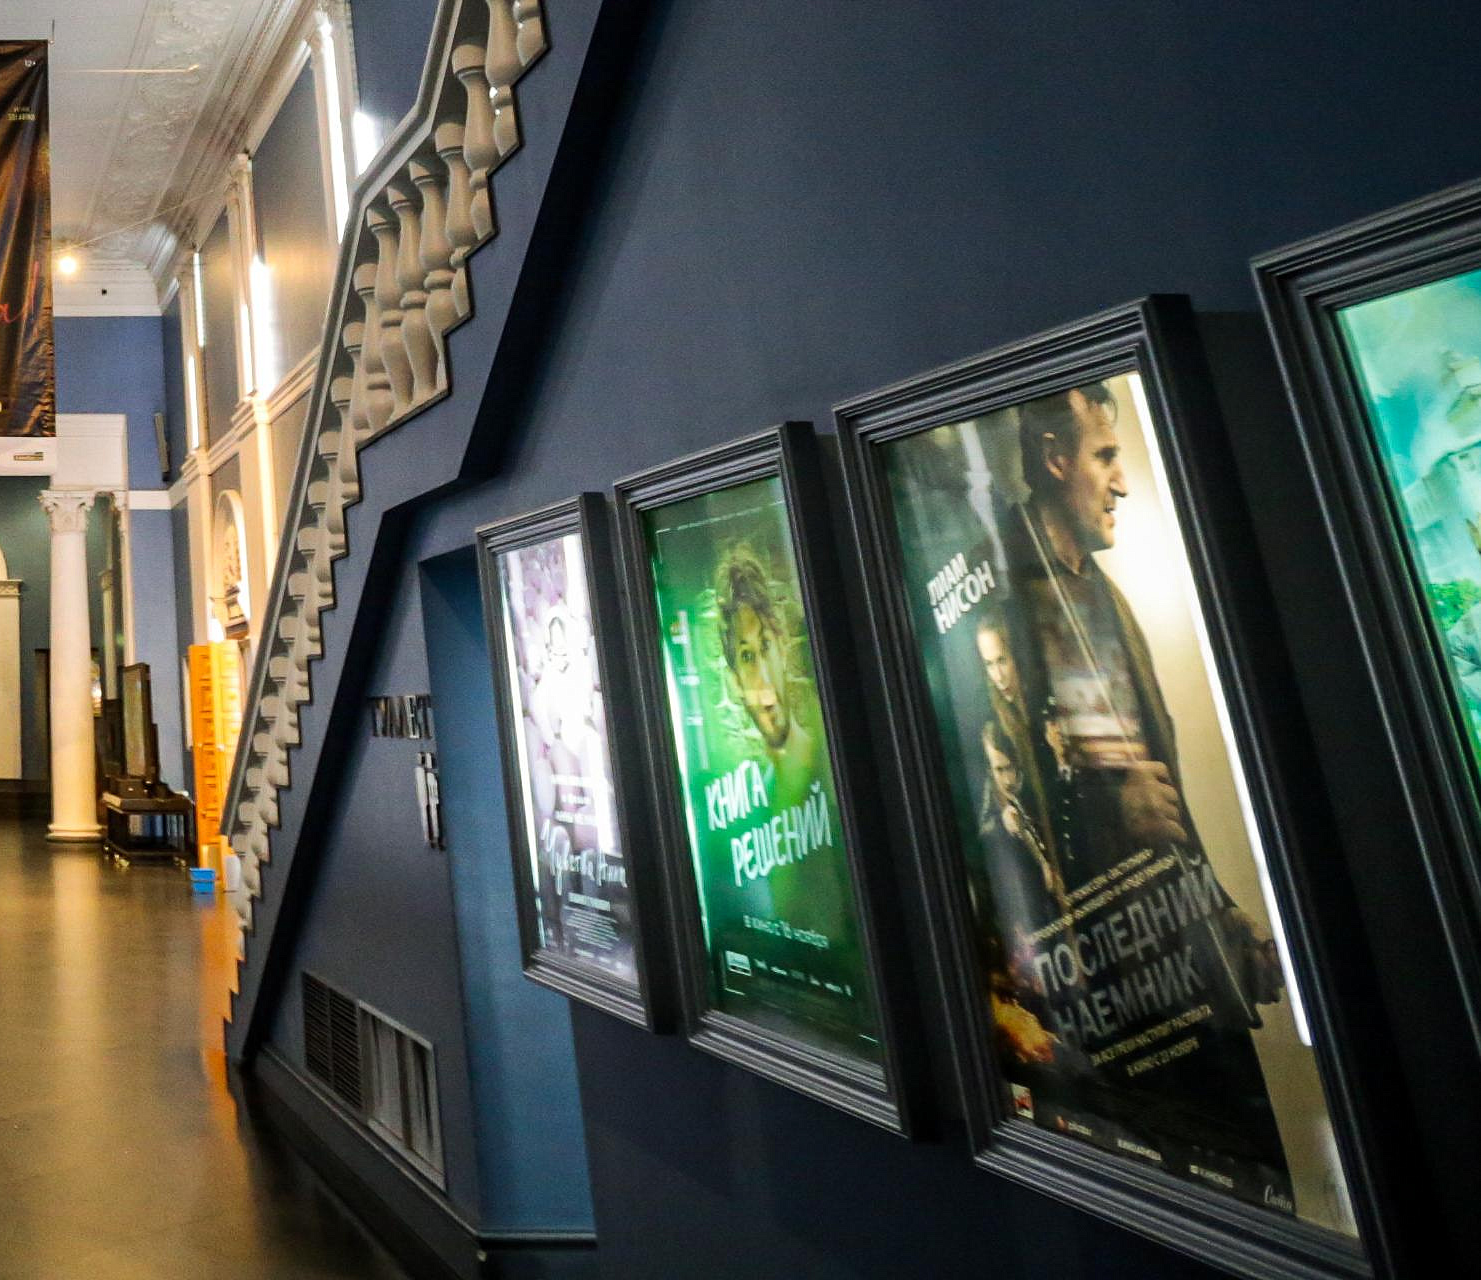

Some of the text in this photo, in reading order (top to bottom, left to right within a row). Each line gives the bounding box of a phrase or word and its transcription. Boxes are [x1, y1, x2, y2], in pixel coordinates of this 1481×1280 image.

[926, 551, 969, 607] ЛИАМ
[933, 560, 996, 635] НИСОН
[703, 759, 769, 832] КНИГА
[730, 780, 833, 888] РЕШЕНИЙ
[1032, 853, 1225, 999] ПОСЛЕДНИЙ
[1052, 945, 1206, 1048] НАЕМНИК
